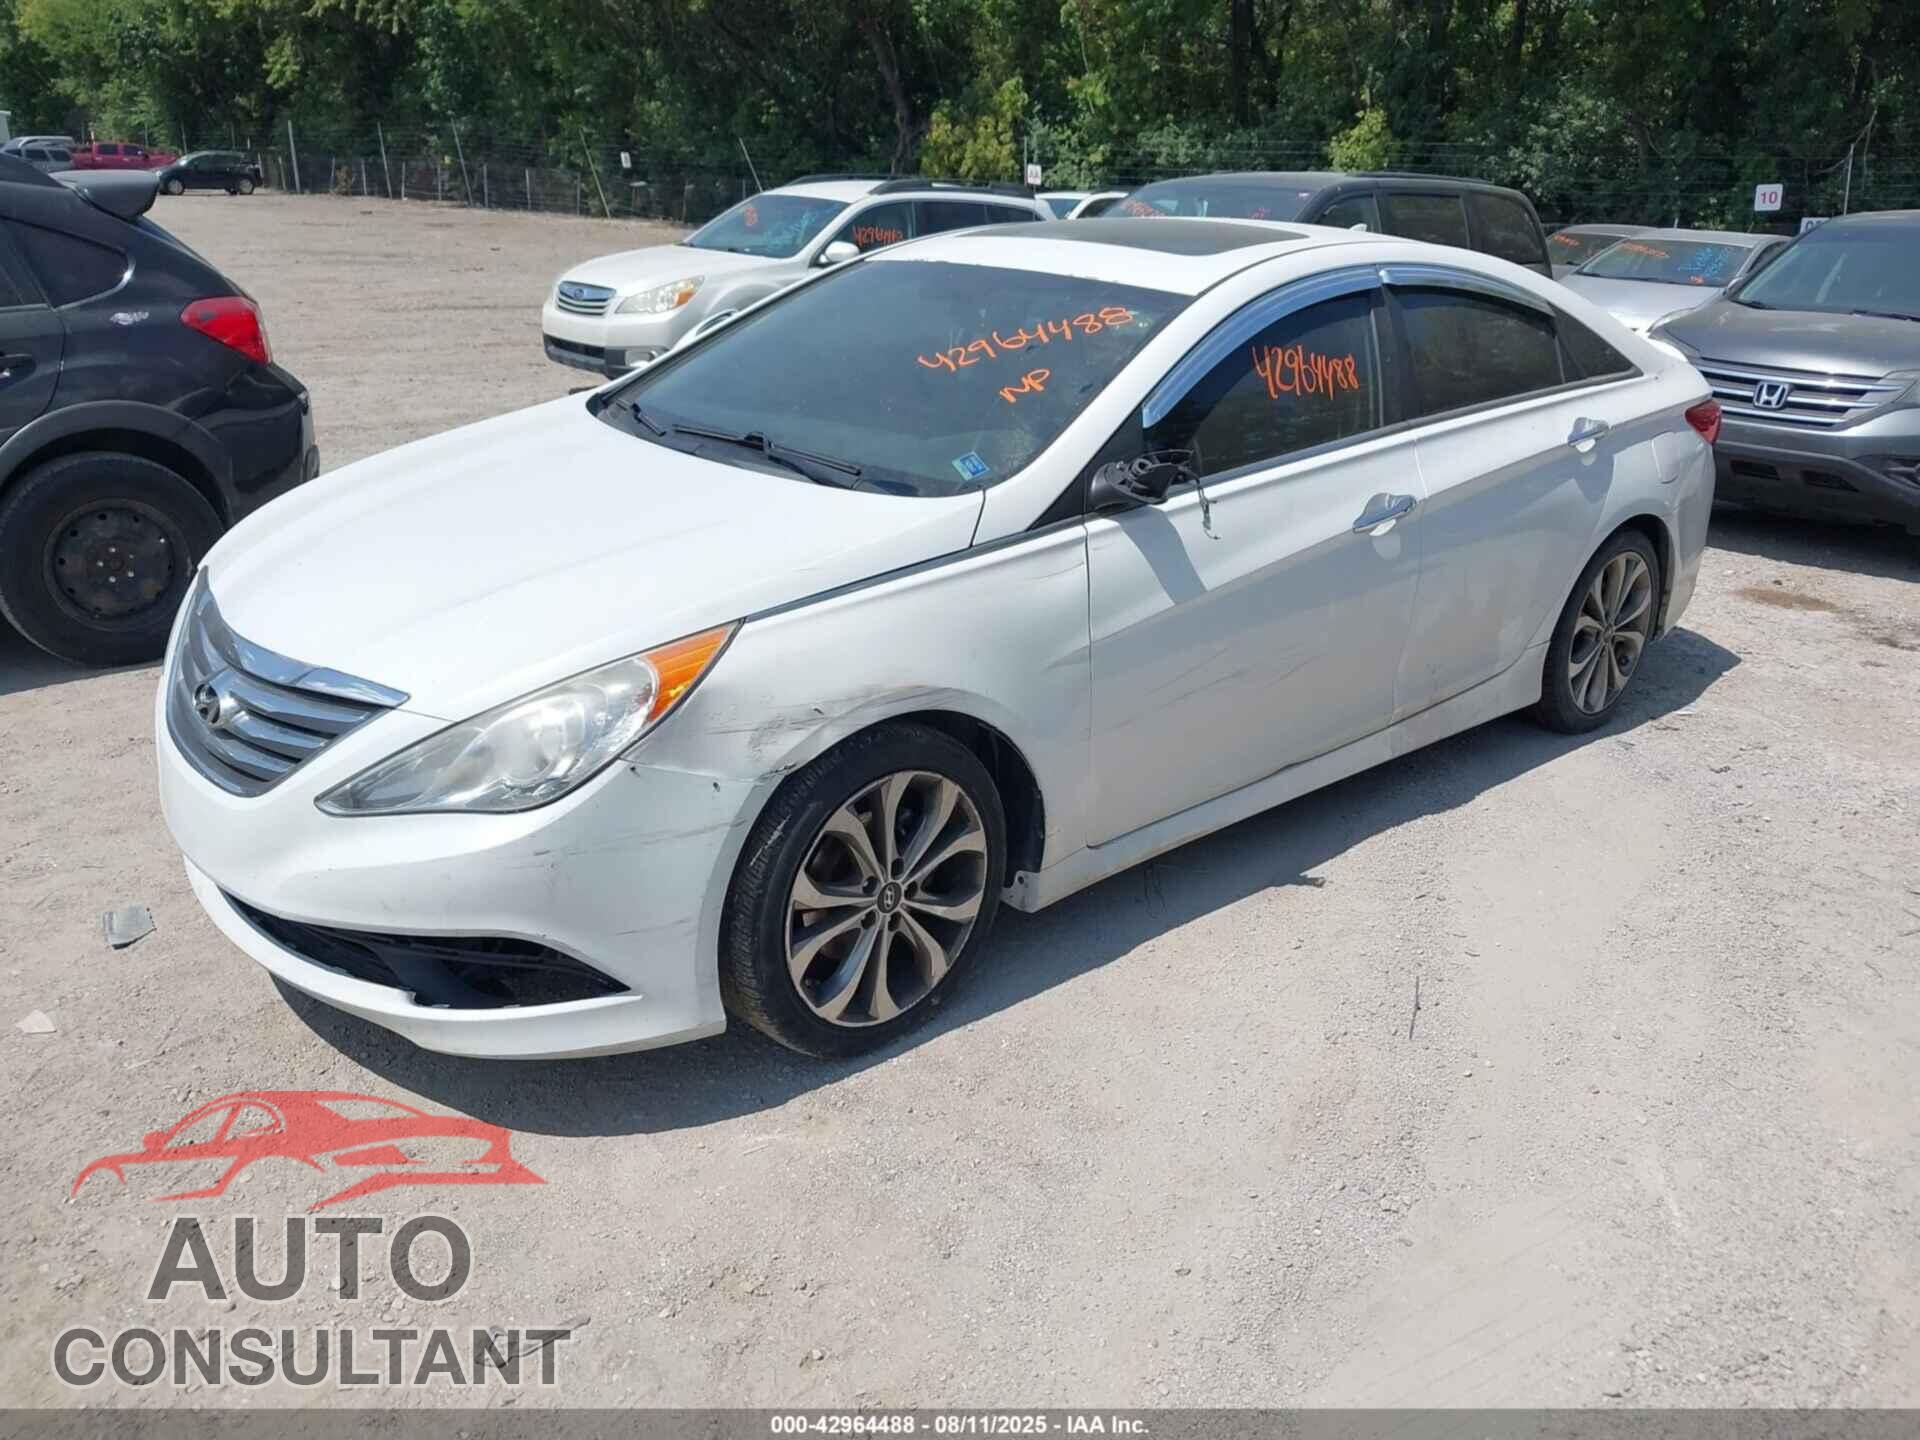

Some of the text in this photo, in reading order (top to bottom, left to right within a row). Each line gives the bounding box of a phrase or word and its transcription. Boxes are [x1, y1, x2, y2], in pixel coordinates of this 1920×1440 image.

[1760, 191, 1778, 204] 10
[917, 306, 1133, 373] 42964488
[999, 367, 1051, 404] NP
[1251, 345, 1360, 401] 42964488
